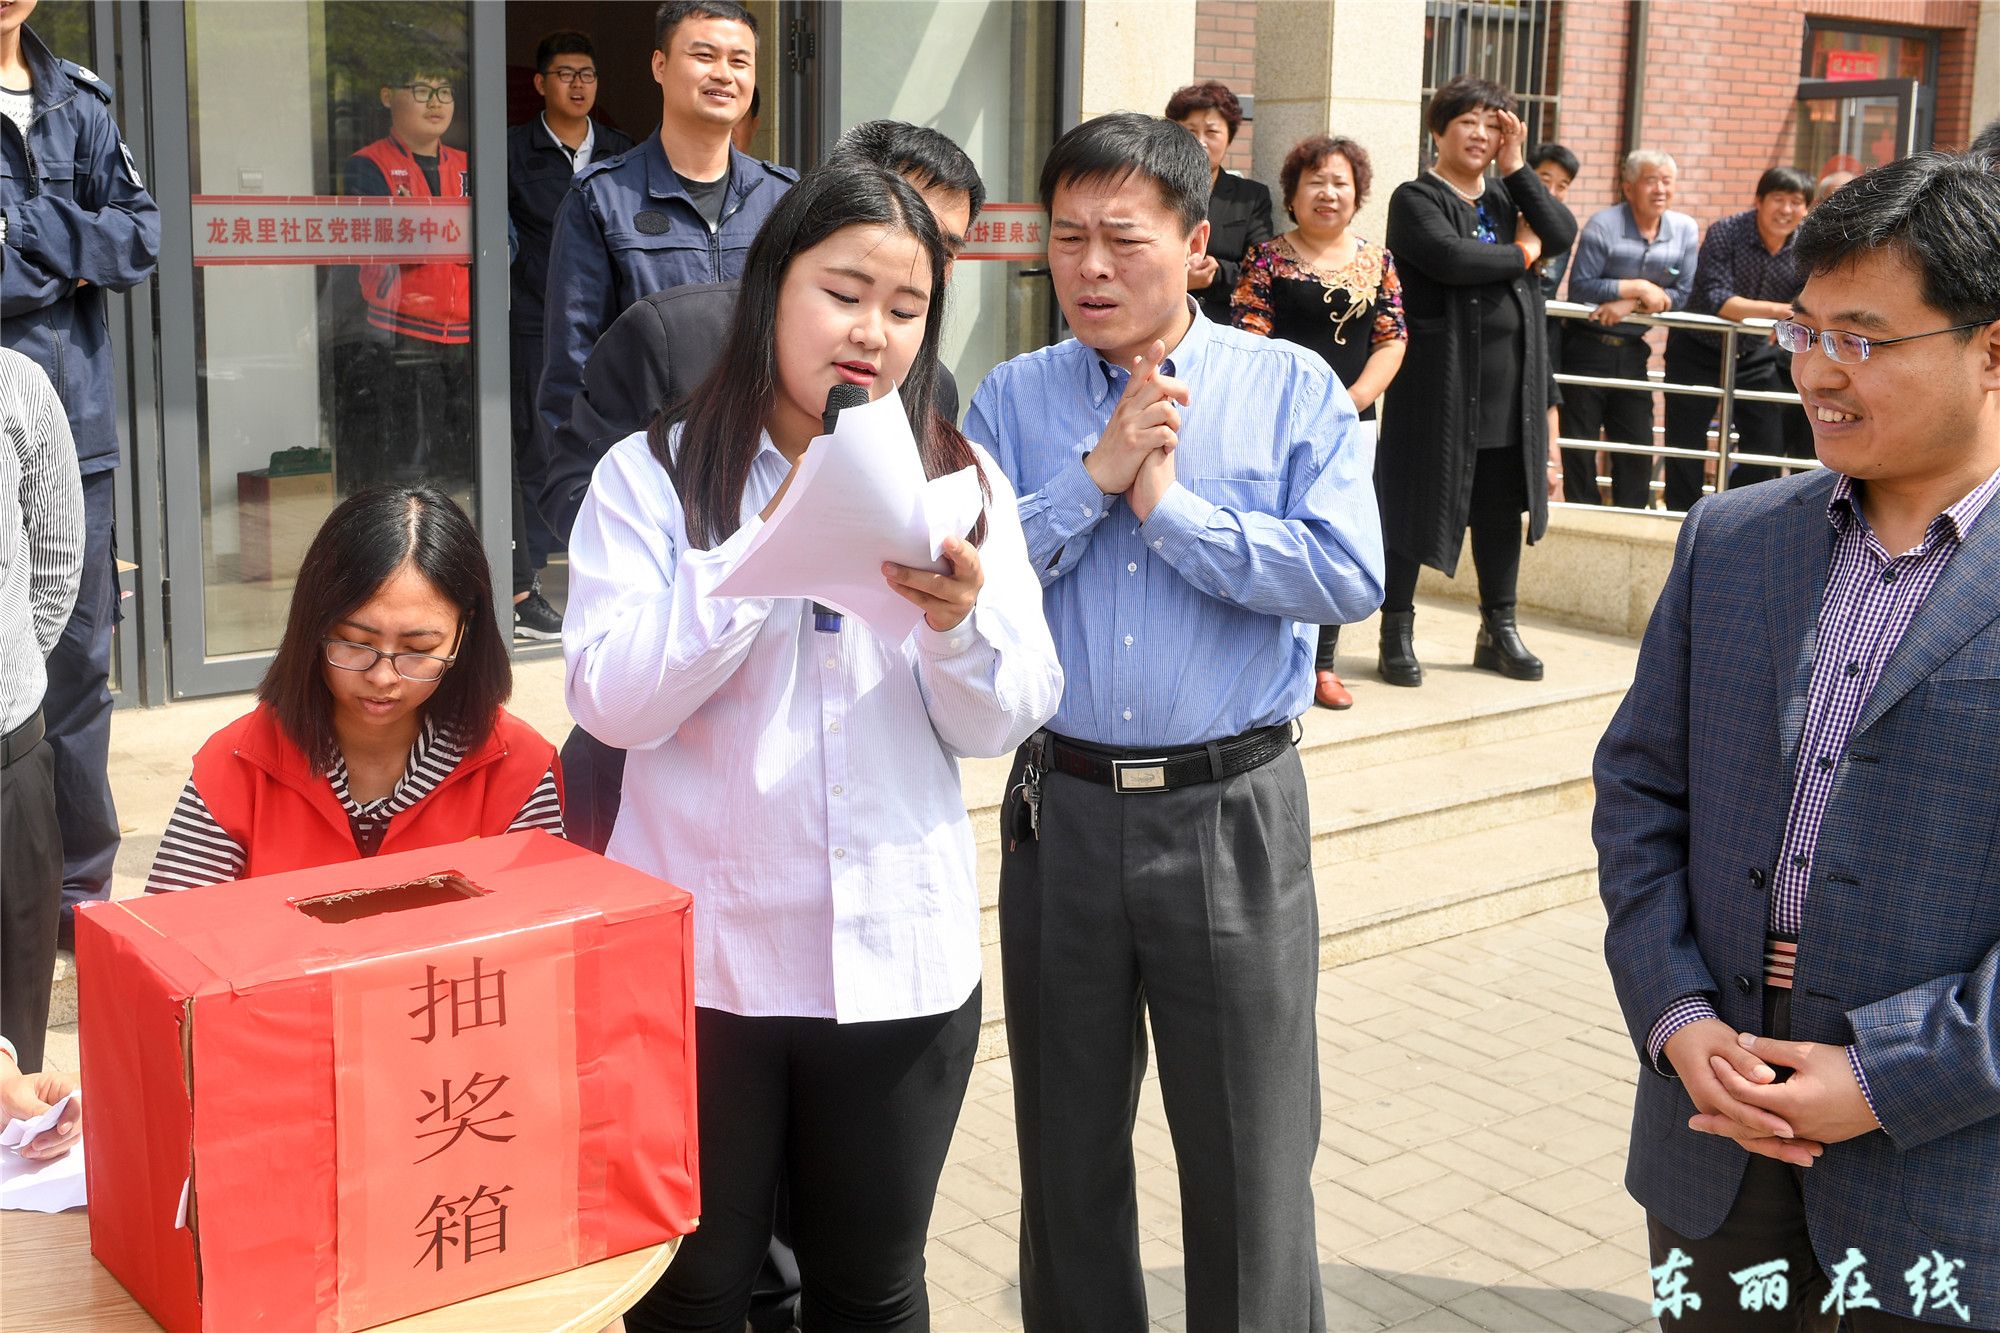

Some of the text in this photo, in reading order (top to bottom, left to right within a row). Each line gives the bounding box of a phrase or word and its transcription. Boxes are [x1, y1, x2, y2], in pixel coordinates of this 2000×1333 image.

[206, 216, 461, 244] 龙泉里社区党群服务中心
[407, 956, 517, 1272] 抽奖箱
